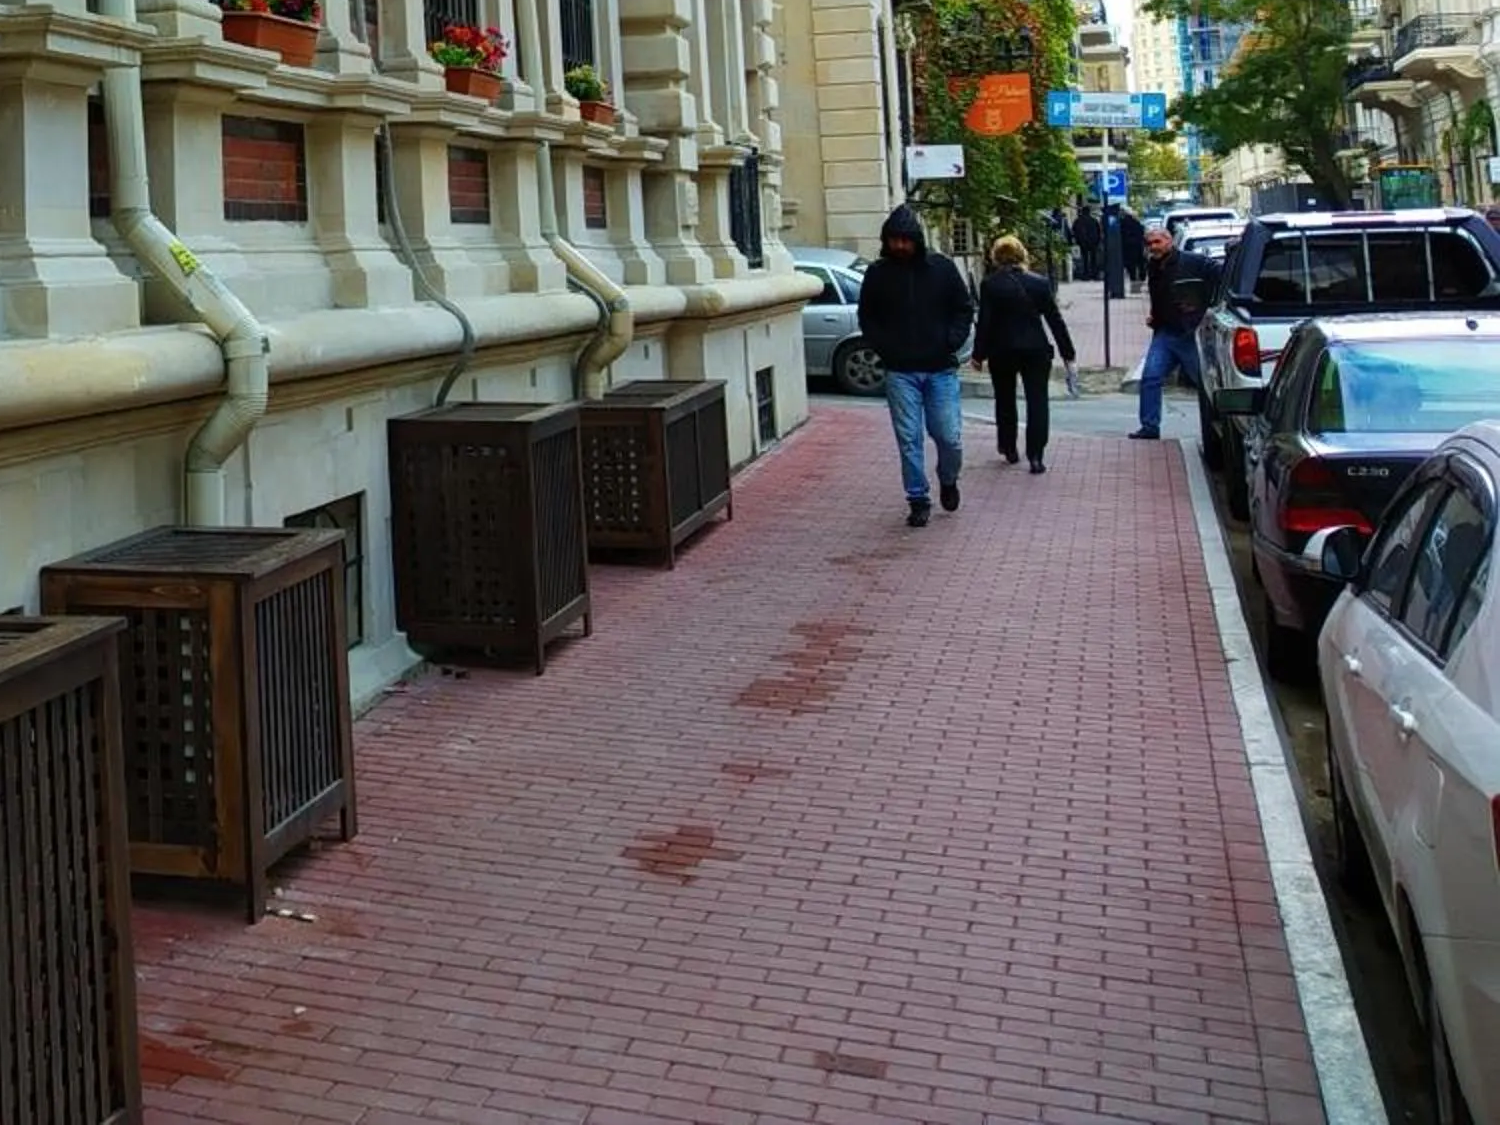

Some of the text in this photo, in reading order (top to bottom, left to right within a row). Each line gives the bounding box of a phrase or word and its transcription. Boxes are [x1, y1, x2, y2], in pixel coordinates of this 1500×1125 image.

[1053, 103, 1066, 116] P
[1147, 104, 1160, 118] P
[1103, 176, 1119, 193] P
